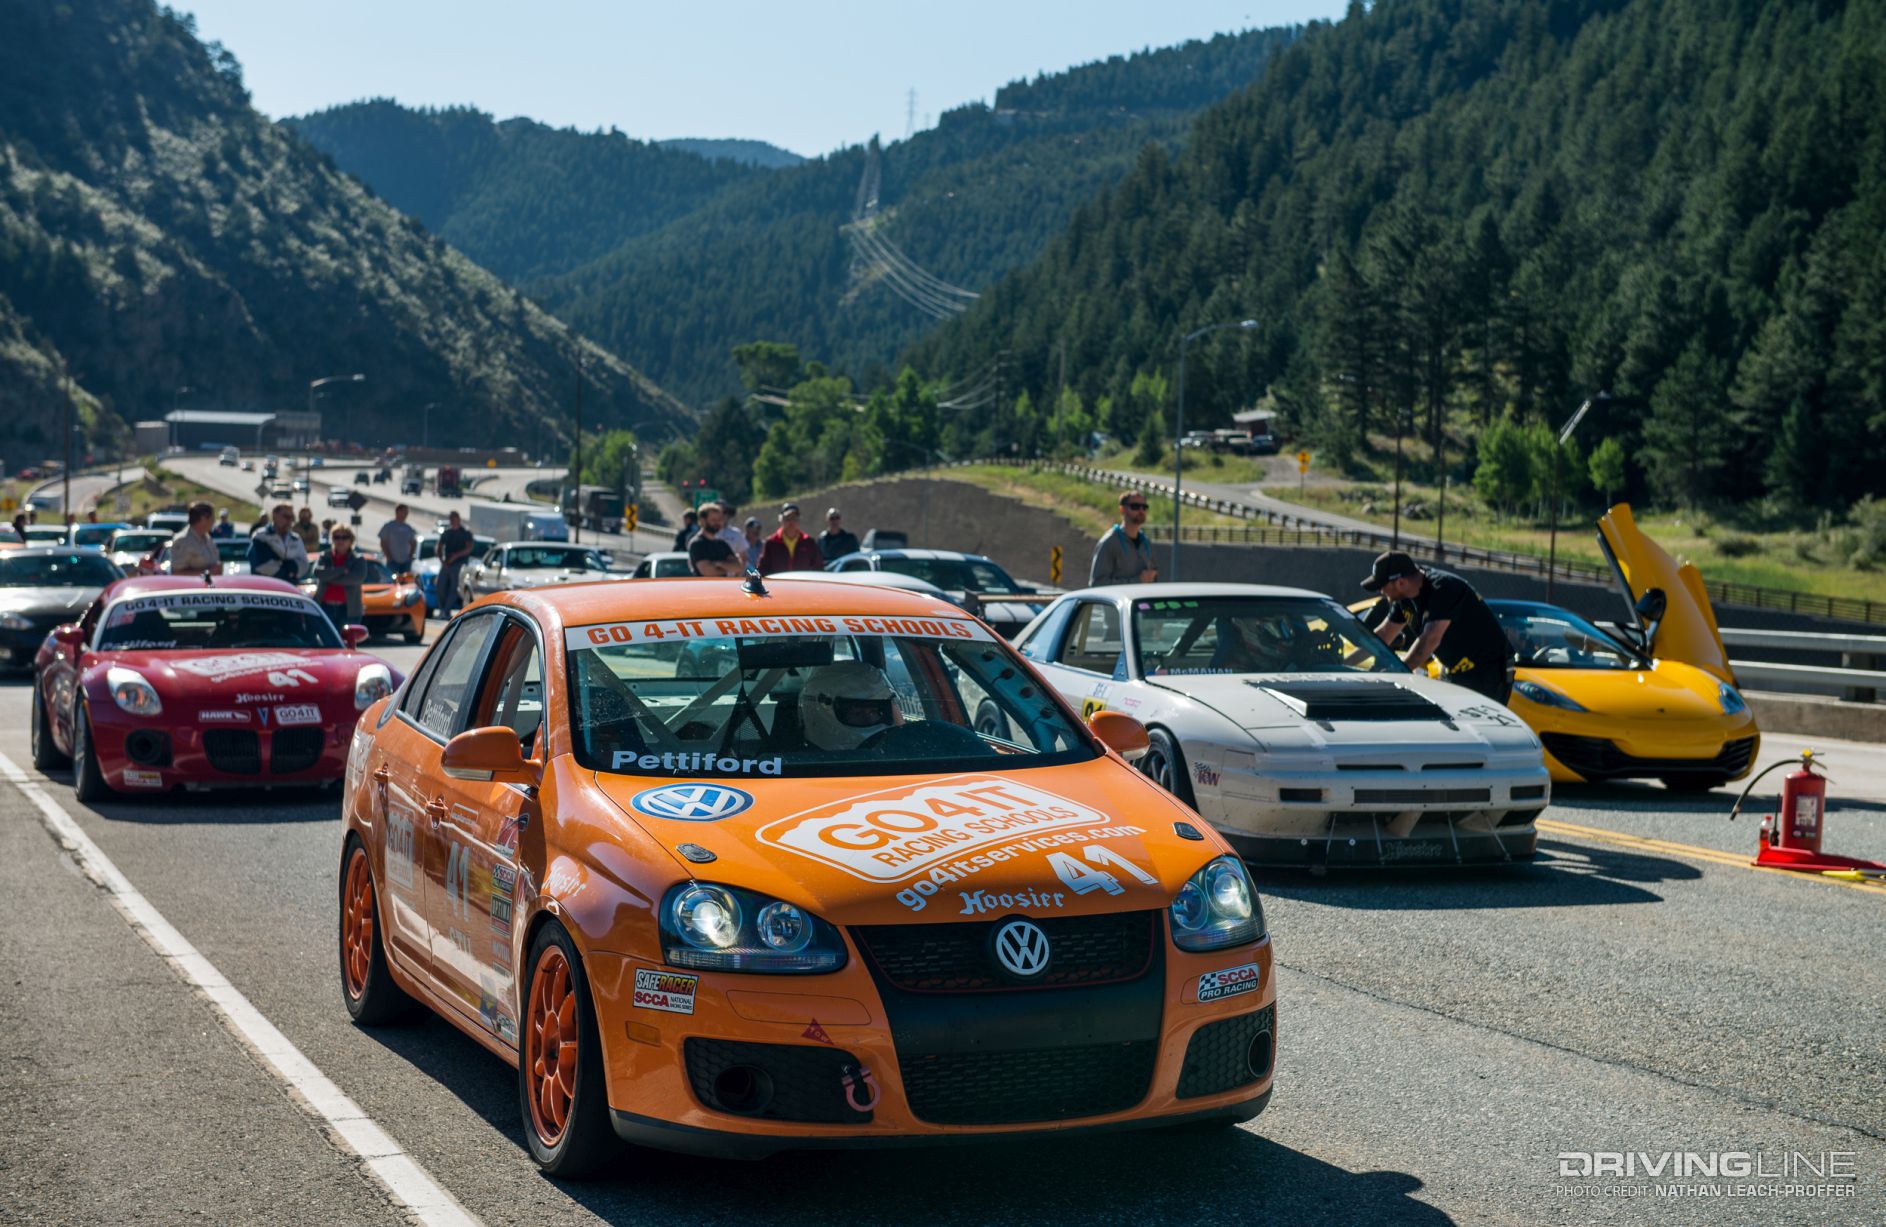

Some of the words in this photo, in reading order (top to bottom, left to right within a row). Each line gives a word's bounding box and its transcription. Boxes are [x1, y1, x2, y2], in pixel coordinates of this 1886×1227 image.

[125, 601, 145, 611] GO
[149, 599, 176, 608] 4-IT
[181, 596, 236, 606] RACING
[242, 596, 304, 610] SCHOOLS
[586, 625, 633, 645] GO
[643, 621, 704, 639] 4-IT
[714, 618, 837, 636] RACING
[842, 618, 973, 638] SCHOOLS
[268, 669, 320, 687] 41
[201, 711, 233, 719] HAWK
[280, 708, 315, 718] GO4IT
[611, 750, 782, 775] Pettiford
[818, 786, 1039, 850] GO4IT
[871, 828, 973, 868] RACING
[963, 805, 1080, 834] SCHOOLS
[447, 840, 470, 922] 41
[895, 825, 1148, 912] go4itservices.com
[1045, 844, 1159, 896] 41
[959, 887, 1065, 915] Hoosier
[1217, 968, 1257, 985] SCCA
[634, 991, 670, 1008] SCCA
[1201, 988, 1221, 999] PRO
[1224, 980, 1257, 994] RACING
